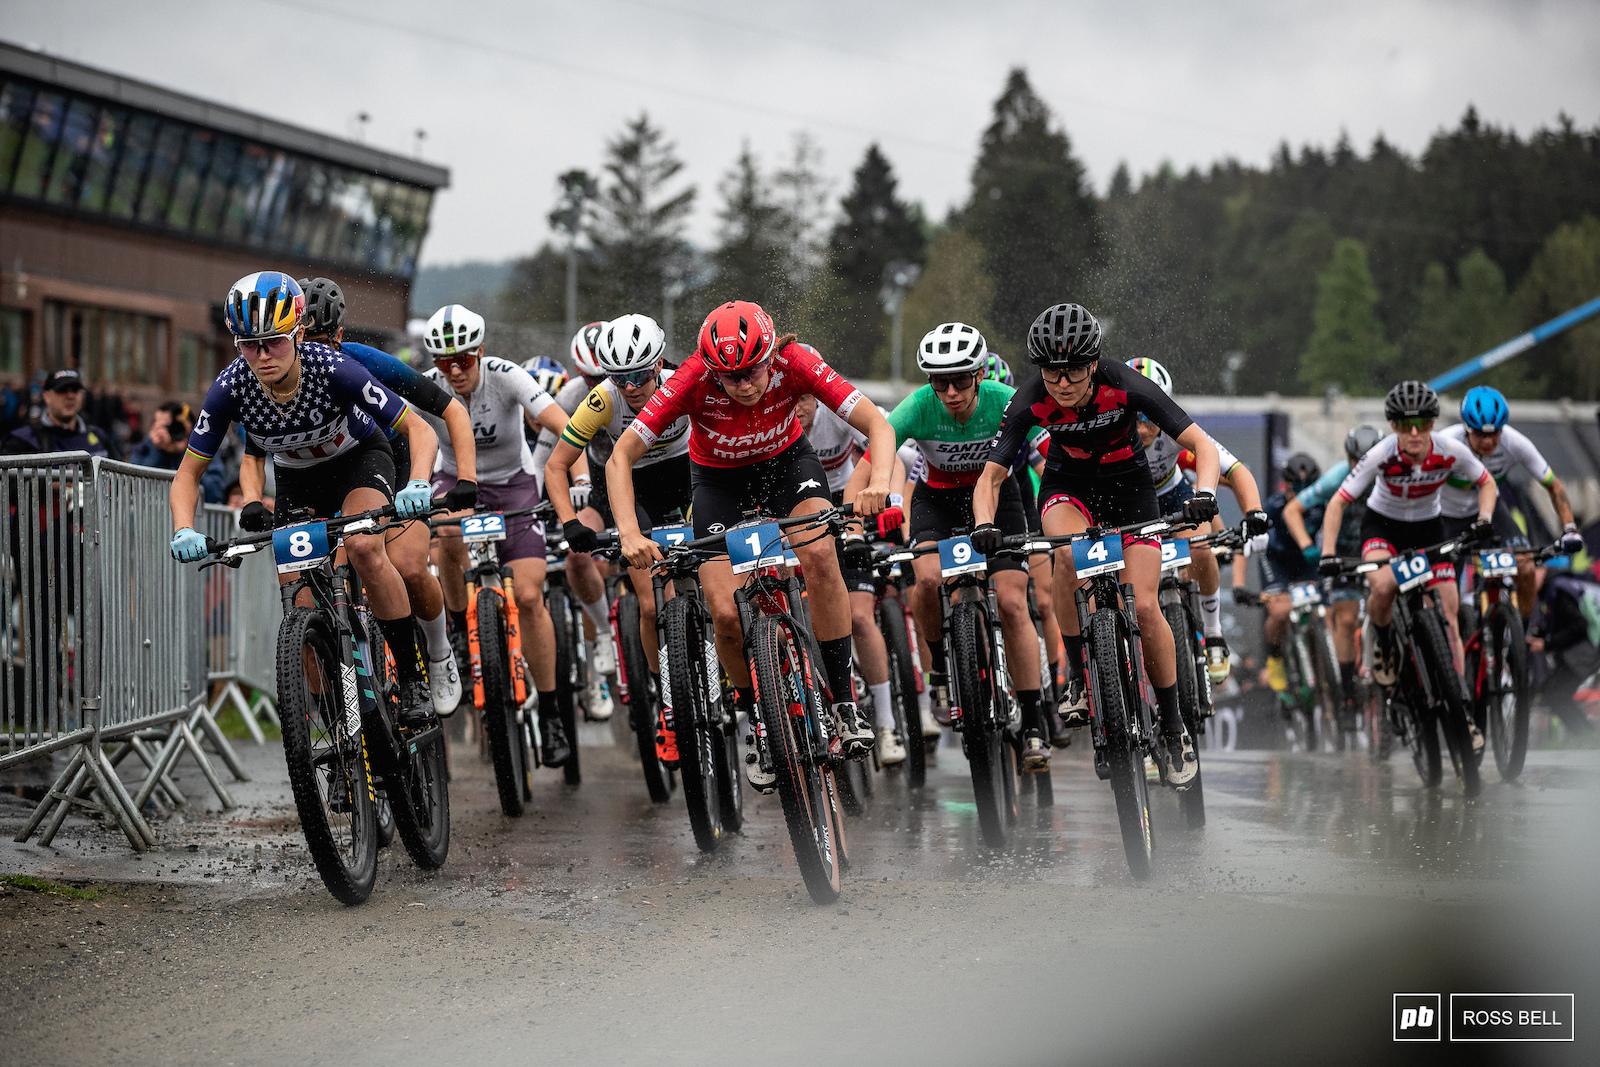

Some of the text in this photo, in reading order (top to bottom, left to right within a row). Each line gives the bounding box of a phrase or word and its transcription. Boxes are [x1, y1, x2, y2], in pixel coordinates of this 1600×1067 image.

[248, 412, 342, 447] SCOTT
[713, 435, 789, 459] maxon
[936, 440, 991, 454] SANTA
[947, 451, 991, 463] CRUZ
[940, 462, 986, 472] ROCKSHO
[464, 516, 502, 533] 22
[289, 531, 313, 557] 8
[745, 532, 762, 556] 1
[952, 542, 972, 564] 9
[1087, 541, 1109, 562] 4
[1398, 556, 1426, 579] 10
[1486, 552, 1514, 568] 16
